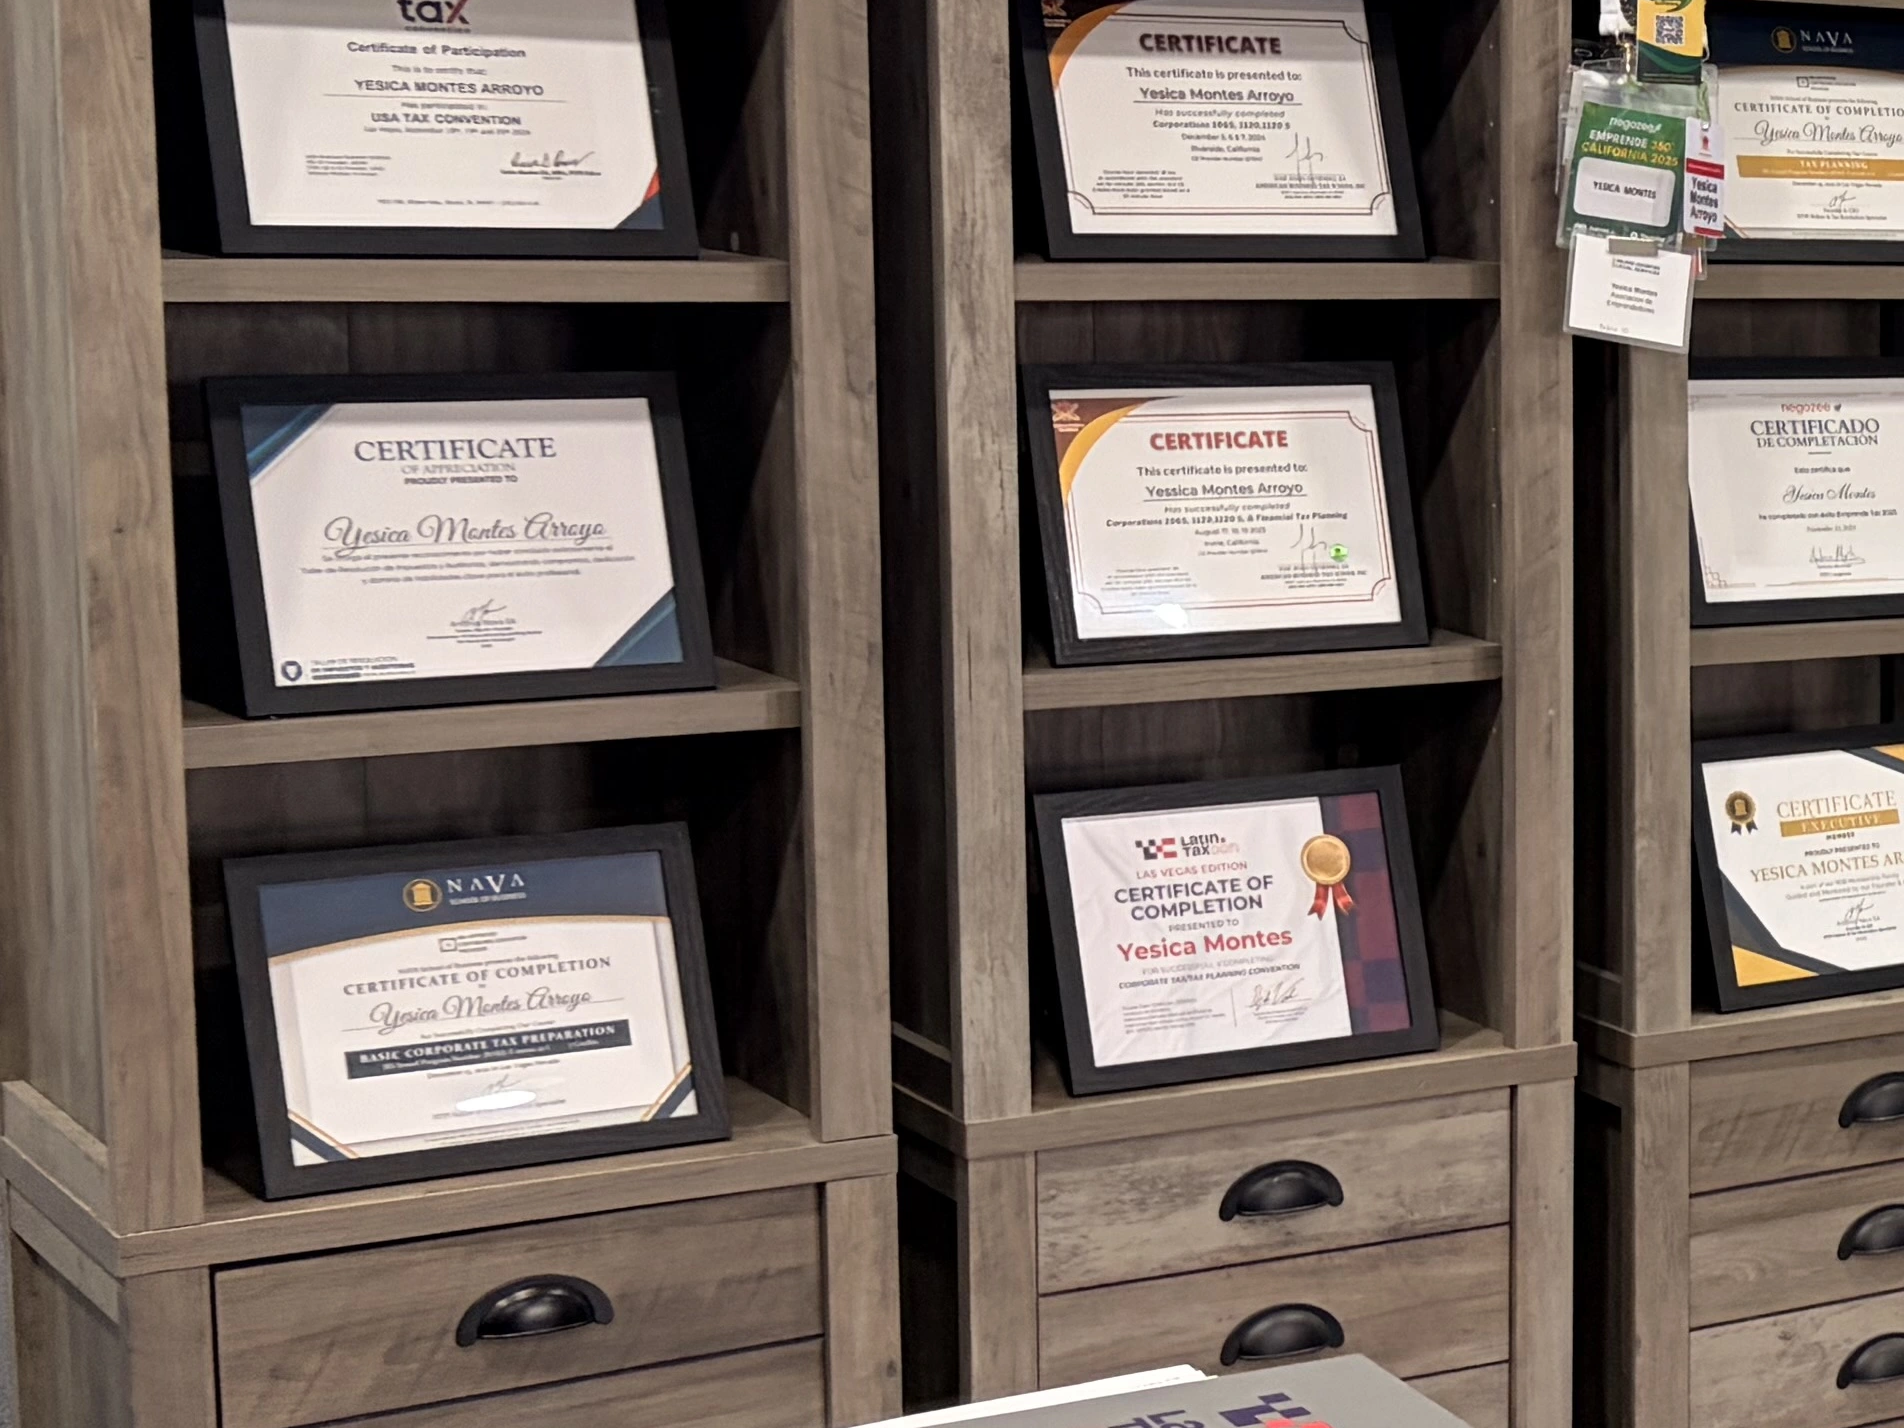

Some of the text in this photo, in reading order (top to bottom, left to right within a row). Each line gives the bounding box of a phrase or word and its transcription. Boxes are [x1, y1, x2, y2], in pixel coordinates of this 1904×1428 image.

[1139, 33, 1282, 55] CERTIFICATE
[1800, 29, 1853, 47] NAVA
[347, 42, 527, 60] Certificate of Participation
[1126, 66, 1151, 78] This
[1153, 67, 1213, 80] certificate
[1215, 69, 1224, 80] is
[1228, 70, 1283, 83] presented
[355, 79, 545, 97] YESICA MONTES ARROYO
[1139, 87, 1295, 104] Yesica Montes Arroyo
[1734, 102, 1812, 115] CERTIFICATE
[1816, 104, 1832, 115] OF
[371, 113, 521, 126] USA TAX CONVENTION
[1590, 130, 1648, 149] EMPRENDE
[1754, 120, 1903, 147] Yesica Montes Arroyo
[1581, 142, 1648, 162] CALIFORNIA
[1594, 181, 1656, 199] YESICA MONTES
[1692, 177, 1717, 194] Yesica
[1690, 190, 1718, 208] Montes
[1690, 206, 1717, 224] Arroyo
[1750, 418, 1880, 437] CERTIFICADO
[354, 437, 557, 462] CERTIFICATE
[1150, 430, 1288, 451] CERTIFICATE
[1757, 433, 1879, 448] DE COMPLETACIÓN
[423, 462, 516, 475] APPRECIATION
[1137, 466, 1161, 477] This
[1164, 464, 1221, 476] certificate
[1223, 464, 1232, 475] is
[1235, 463, 1290, 476] presented
[1146, 482, 1303, 498] Yessica Montes Arroyo
[324, 511, 606, 558] Yesica Montes Arroyo
[1777, 790, 1897, 818] CERTIFICATE
[1137, 860, 1248, 880] LAS VEGAS EDITION
[1750, 864, 1807, 883] YESICA
[1812, 856, 1879, 876] MONTES
[446, 873, 526, 895] NAVA
[1114, 874, 1273, 904] CERTIFICATE OF
[1131, 894, 1263, 921] COMPLETION
[1169, 919, 1239, 932] PRESENTED TO
[1118, 929, 1292, 962] Yesica Montes
[342, 956, 611, 997] CERTIFICATE OF COMPLETION
[370, 986, 591, 1035] Yesica Montes Arroyo
[405, 1039, 489, 1060] CORPORATE
[492, 1035, 518, 1051] TAX
[522, 1023, 616, 1046] PREPARATION
